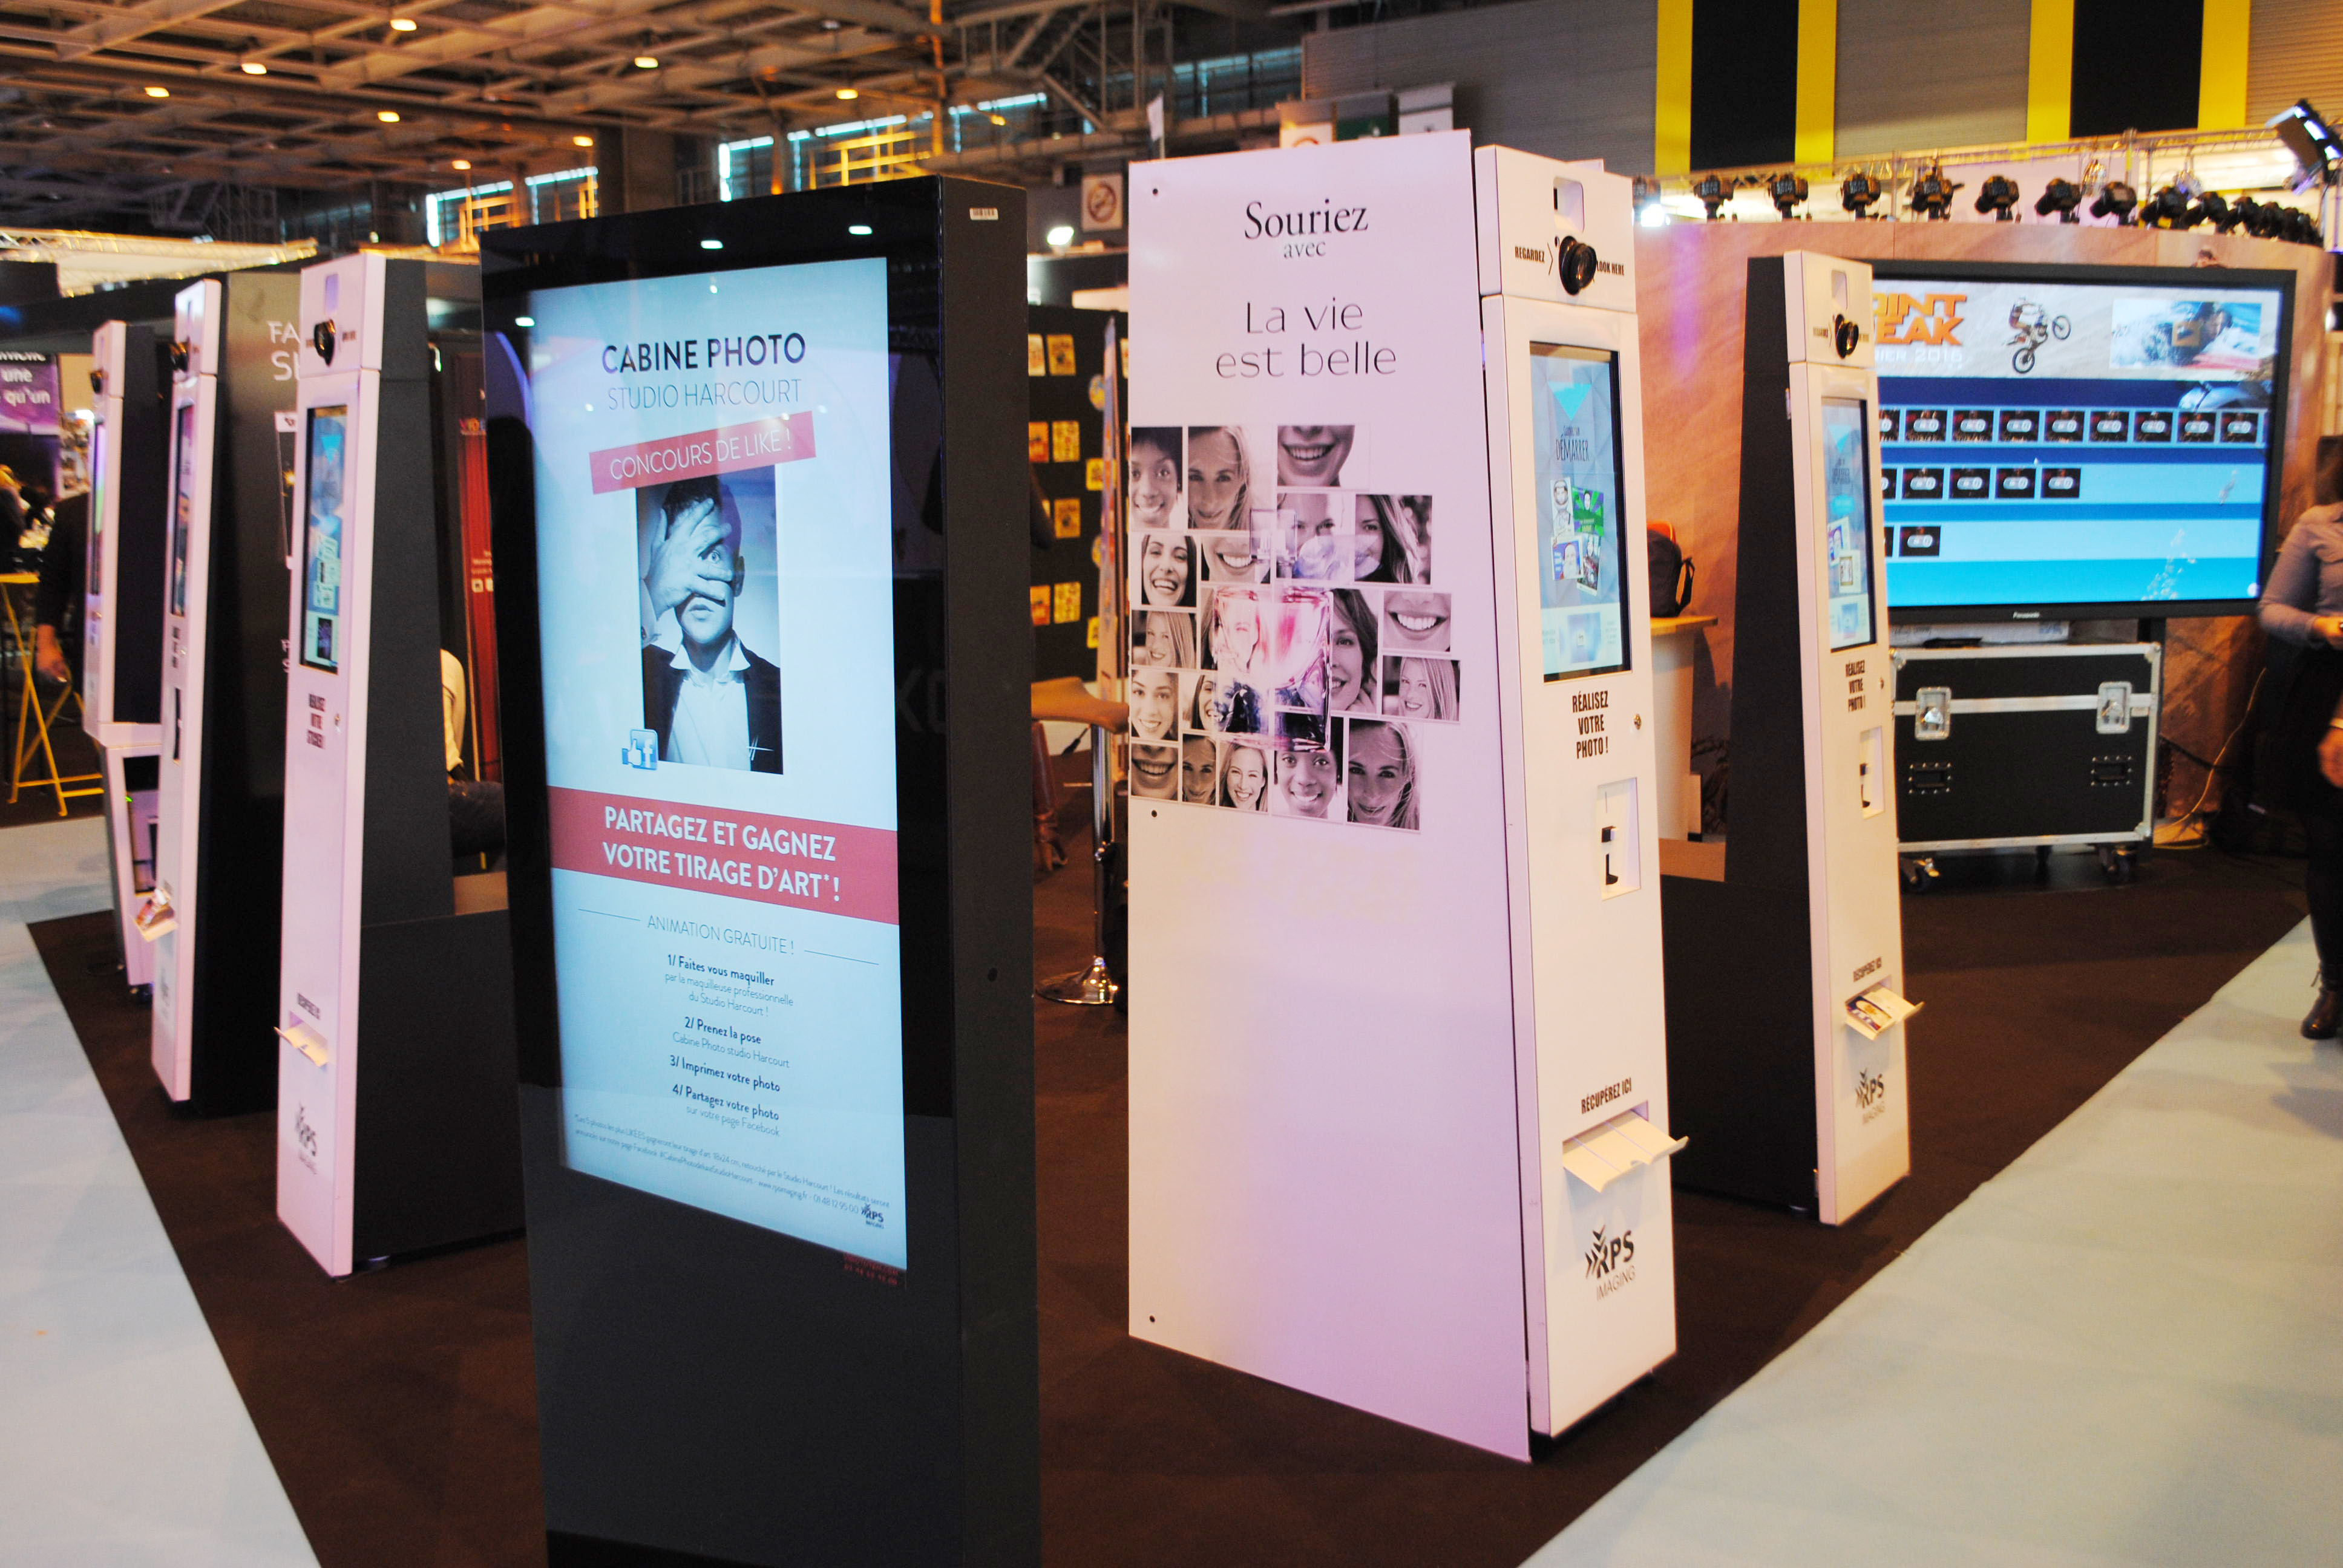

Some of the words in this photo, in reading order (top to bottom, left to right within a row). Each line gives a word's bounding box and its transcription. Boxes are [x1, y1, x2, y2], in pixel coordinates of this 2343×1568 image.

[1244, 198, 1369, 240] Souriez
[1283, 241, 1326, 259] avec
[1515, 246, 1545, 264] REGARDEZ
[1611, 263, 1625, 276] HERE
[1247, 301, 1285, 334] La
[1305, 296, 1363, 331] vie
[1873, 315, 1965, 345] EAK
[603, 339, 698, 374] CABINE
[708, 332, 806, 368] PHOTO
[1216, 348, 1285, 379] est
[1300, 341, 1397, 377] belle
[608, 384, 679, 411] STUDIO
[685, 379, 802, 407] HARCOURT
[609, 441, 713, 481] CONCOURS
[716, 438, 739, 461] DE
[745, 430, 781, 458] LIKE
[787, 428, 791, 450] !
[1556, 434, 1590, 462] DÉMARRER
[1572, 690, 1609, 713] RÉALISEZ
[1578, 714, 1605, 736] VOTRE
[1576, 738, 1604, 759] PHOTO
[1605, 736, 1609, 754] !
[605, 806, 707, 843] PARTAGEZ
[713, 821, 737, 846] ET
[742, 825, 836, 861] GAGNEZ
[602, 841, 670, 875] VOTRE
[675, 852, 752, 888] TIRAGE
[833, 877, 841, 901] !
[647, 915, 721, 941] ANIMATION
[724, 929, 787, 954] GRATUITE
[790, 939, 795, 955] !
[668, 954, 677, 967] 1/
[679, 956, 705, 973] Faites
[708, 965, 727, 977] vous
[730, 970, 775, 987] maquiller
[665, 973, 677, 985] par
[678, 973, 685, 984] la
[687, 978, 732, 993] maquilleuse
[734, 987, 794, 1007] professionnelle
[689, 991, 699, 1002] du
[700, 992, 726, 1008] Studio
[727, 999, 764, 1016] Harcourt
[684, 1016, 695, 1029] 2/
[697, 1019, 727, 1037] Prenez
[729, 1026, 738, 1039] la
[740, 1032, 762, 1044] pose
[672, 1031, 700, 1048] Cabine
[702, 1037, 725, 1054] Photo
[727, 1044, 751, 1060] studio
[753, 1050, 790, 1068] Harcourt
[670, 1054, 680, 1068] 3/
[682, 1057, 725, 1079] Imprimez
[727, 1070, 750, 1085] votre
[753, 1075, 780, 1093] photo
[673, 1083, 683, 1096] 4/
[686, 1086, 724, 1108] Partagez
[726, 1098, 750, 1114] votre
[752, 1103, 779, 1121] photo
[1581, 1081, 1620, 1114] RÉCUPÉREZ
[1622, 1077, 1632, 1093] ICI
[686, 1105, 698, 1115] sur
[700, 1109, 719, 1121] votre
[721, 1115, 740, 1129] page
[742, 1117, 781, 1137] Facebook
[1596, 1229, 1634, 1279] RPS
[1596, 1264, 1636, 1302] IMAGING
